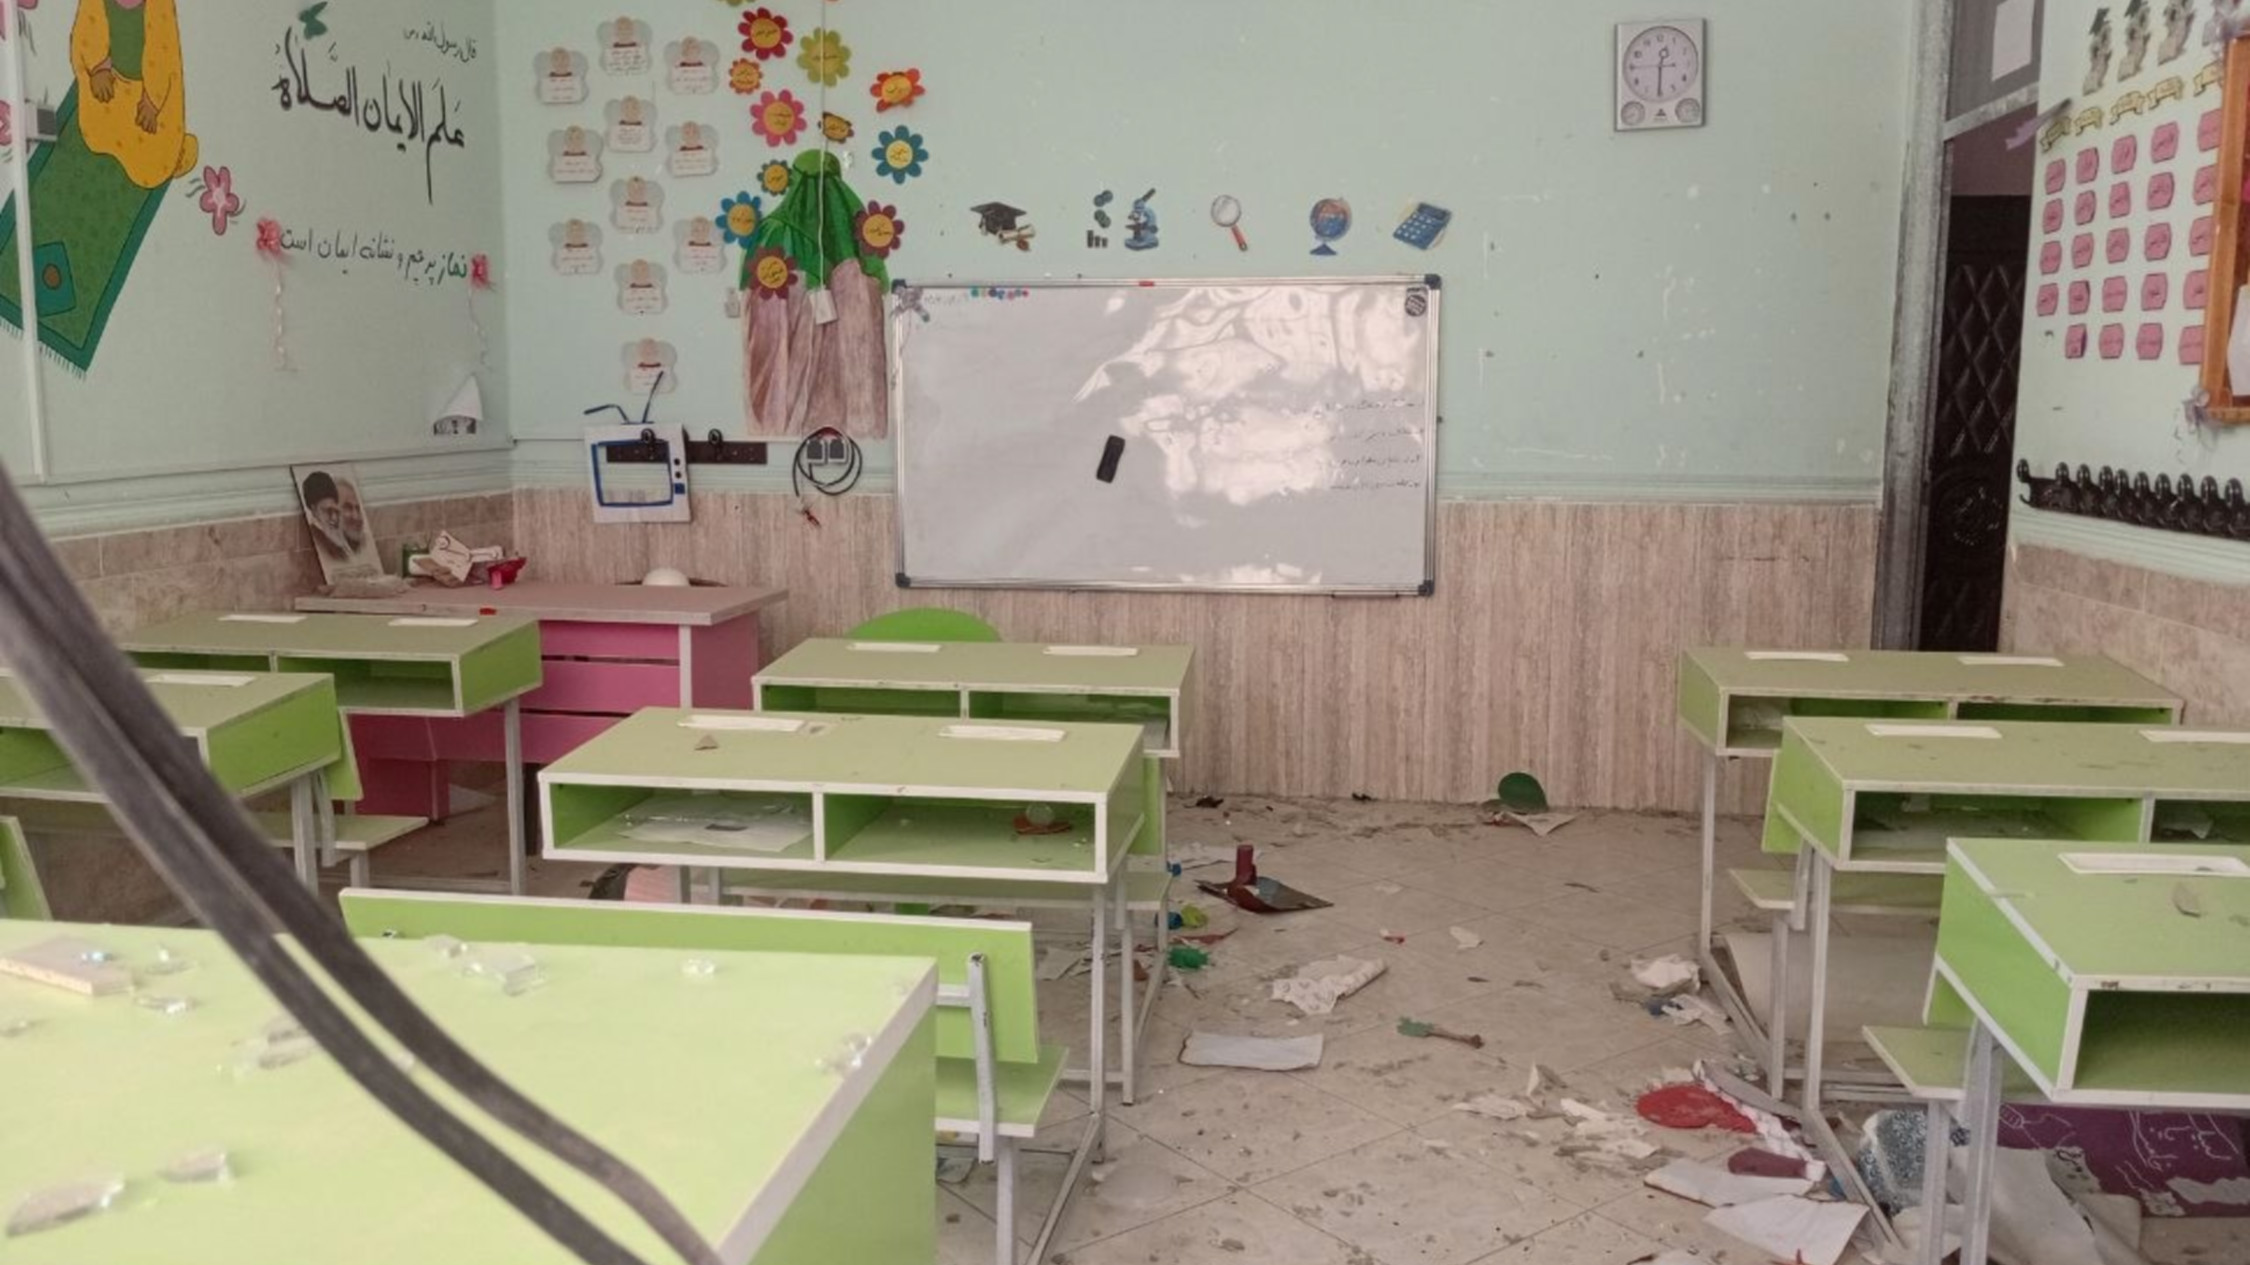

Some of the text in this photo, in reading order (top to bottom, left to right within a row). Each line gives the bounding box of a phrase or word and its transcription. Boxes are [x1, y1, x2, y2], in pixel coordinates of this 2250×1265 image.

[280, 227, 313, 253] است
[317, 229, 358, 275] ایمان
[359, 230, 395, 260] نشانه
[437, 251, 468, 285] نماز
